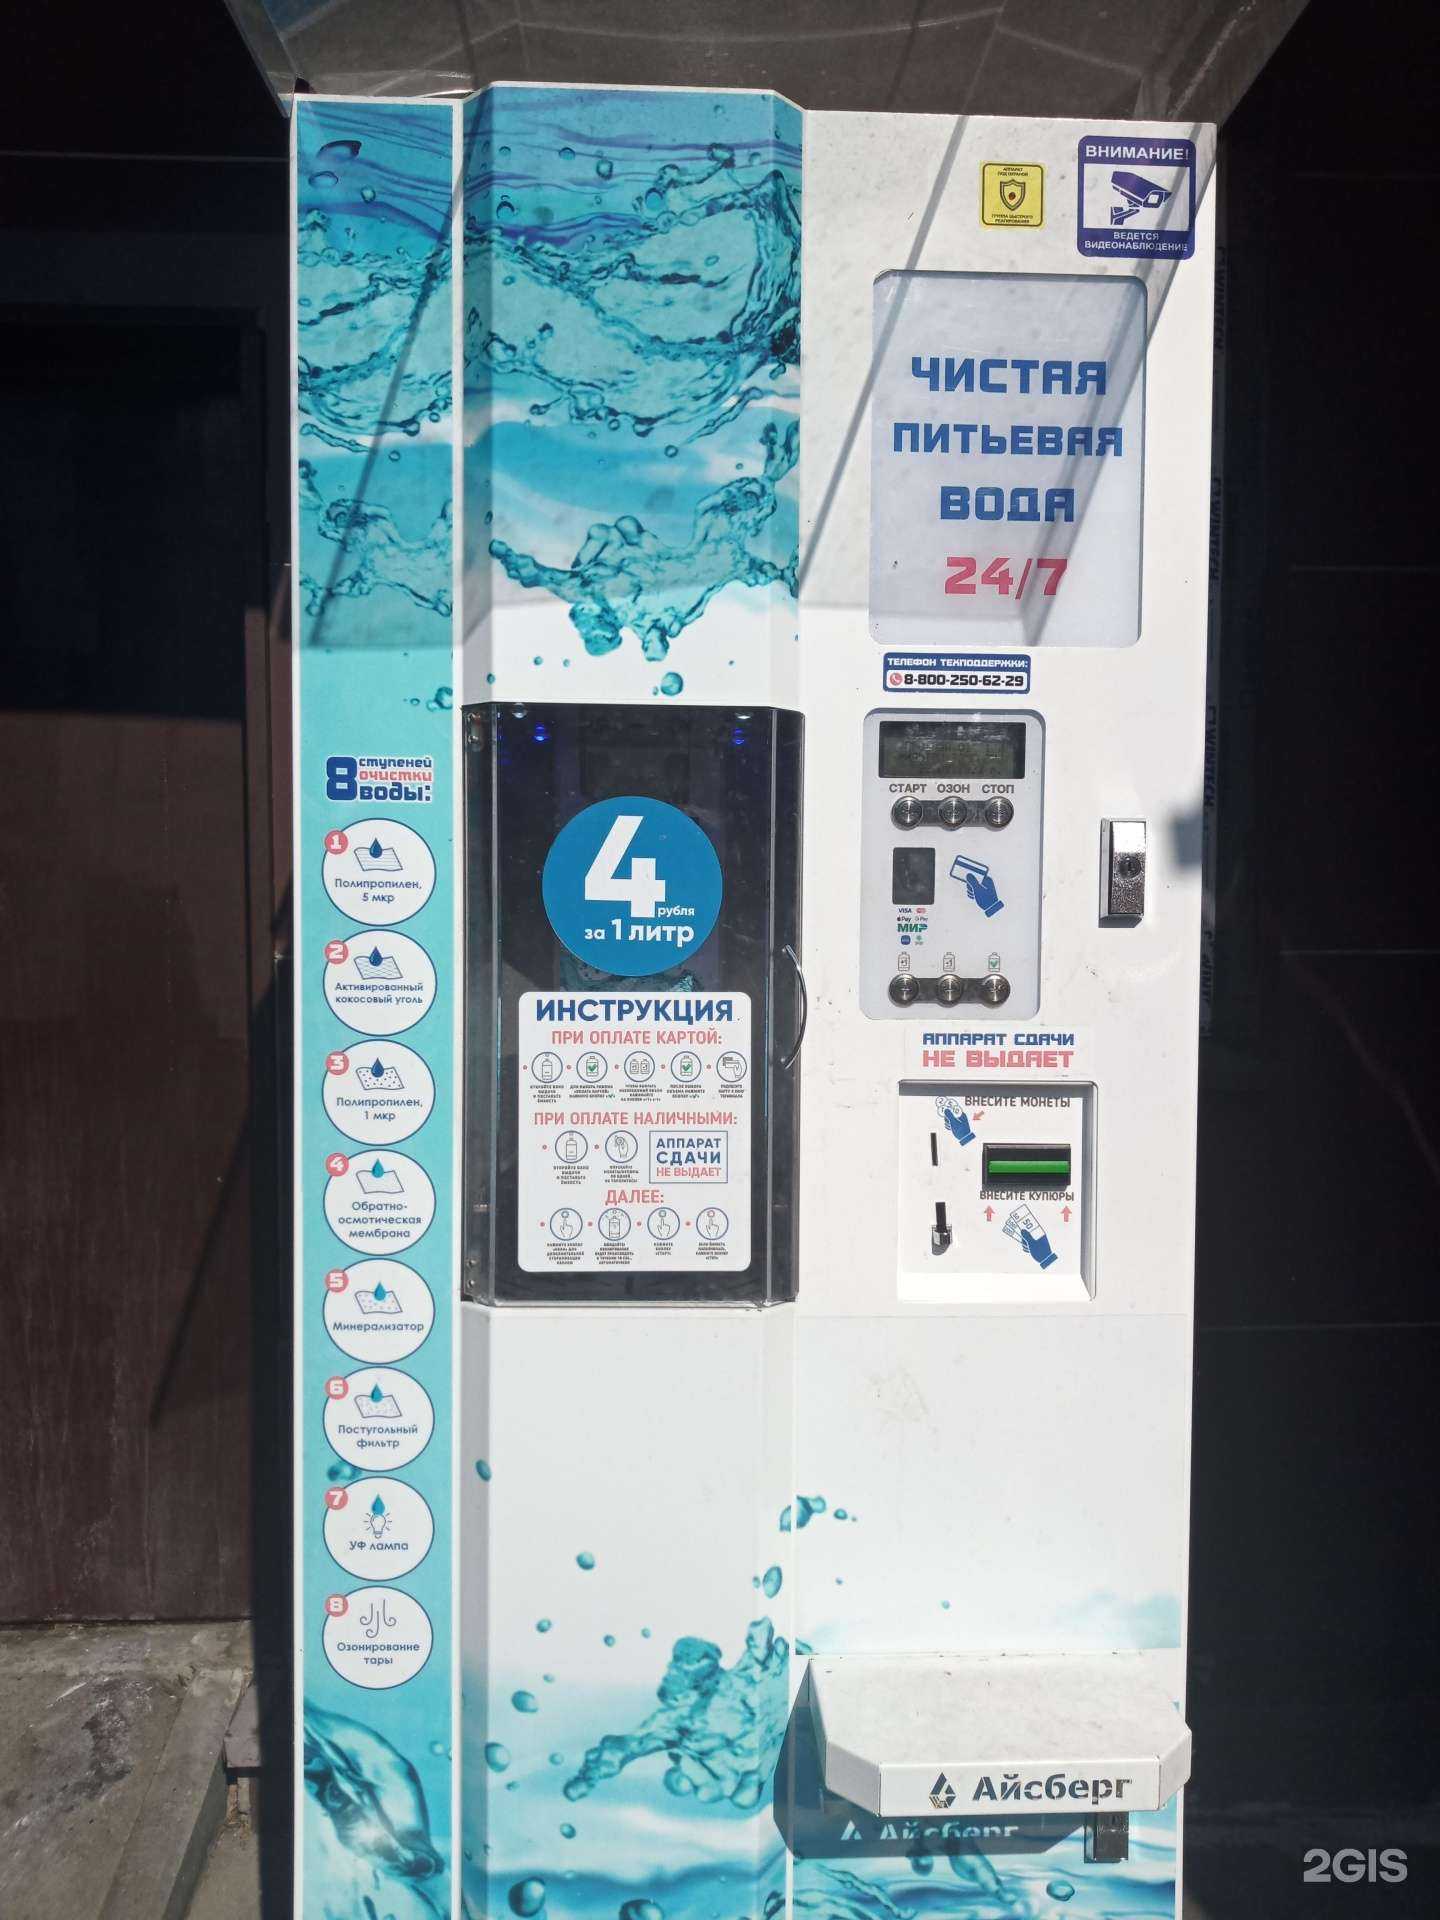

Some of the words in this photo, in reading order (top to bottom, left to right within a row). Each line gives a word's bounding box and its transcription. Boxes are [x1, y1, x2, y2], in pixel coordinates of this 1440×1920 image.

[1086, 145, 1188, 160] ВНИМАНИЕ!
[1113, 232, 1159, 241] ВЕДЕТСЯ
[1084, 241, 1188, 251] ВИДЕОНАБЛЮДЕНИЕ
[911, 356, 1107, 395] ЧИСТАЯ
[893, 423, 1123, 457] ПИТЬЕВАЯ
[940, 486, 1075, 522] ВОДА
[944, 556, 1068, 600] 24/7
[888, 658, 937, 667] ТЕЛЕФОН
[940, 658, 1028, 668] ТЕХПОДДЕРЖКИ:
[904, 674, 1024, 687] 8-800-250-62-29
[359, 757, 432, 769] ступеней
[326, 756, 358, 801] 8
[359, 770, 432, 781] очистки
[359, 785, 432, 801] воды:
[889, 784, 927, 793] СТАРТ
[937, 784, 970, 793] ОЗОН
[982, 784, 1015, 794] СТОП
[331, 835, 342, 850] 1
[585, 815, 666, 918] 4
[335, 878, 422, 893] Полипропилен,
[362, 893, 369, 902] 5
[372, 894, 395, 905] мкр
[657, 906, 695, 918] рубля
[584, 928, 606, 940] за
[611, 919, 622, 941] 1
[628, 925, 695, 948] литр
[329, 944, 344, 960] 2
[335, 982, 424, 994] Активированный
[335, 994, 393, 1004] кокосовый
[395, 995, 423, 1006] уголь
[536, 999, 733, 1025] ИНСТРУКЦИЯ
[552, 1030, 584, 1044] ПРИ
[589, 1030, 650, 1045] ОПЛАТЕ
[656, 1027, 722, 1045] КАРТОЙ:
[923, 1033, 1007, 1045] АППАРАТ
[1014, 1033, 1075, 1046] СДАЧИ
[330, 1055, 345, 1071] 3
[923, 1050, 956, 1067] НЕ
[966, 1050, 1074, 1068] ВЫДАЕТ
[336, 1097, 423, 1110] Полипропилен,
[964, 1096, 1017, 1107] ВНЕСИТЕ
[1020, 1097, 1071, 1108] МОНЕТЫ
[364, 1110, 370, 1121] 1
[373, 1112, 396, 1123] мкр
[534, 1112, 565, 1125] ПРИ
[570, 1112, 629, 1125] ОПЛАТЕ
[634, 1111, 738, 1125] НАЛИЧНЫМИ:
[656, 1138, 722, 1149] АППАРАТ
[330, 1157, 344, 1172] 4
[656, 1151, 721, 1166] СДАЧИ
[656, 1167, 671, 1177] НЕ
[673, 1167, 722, 1178] ВЫДАЕТ
[605, 1190, 664, 1206] ДАЛЕЕ:
[980, 1190, 1026, 1201] ВНЕСИТЕ
[1029, 1191, 1075, 1201] КУПЮРЫ
[352, 1201, 408, 1214] Обратно-
[338, 1216, 422, 1225] осмотическая
[1022, 1218, 1033, 1230] 50
[348, 1228, 410, 1239] мембрана
[329, 1273, 343, 1288] 5
[332, 1321, 425, 1334] Минерализатор
[329, 1380, 344, 1395] 6
[338, 1424, 418, 1437] Постугольный
[356, 1437, 400, 1450] фильтр
[330, 1490, 343, 1506] 7
[349, 1540, 367, 1551] УФ
[369, 1541, 409, 1551] лампа
[330, 1598, 344, 1613] 8
[336, 1642, 420, 1654] Озонирование
[363, 1656, 393, 1667] тары
[972, 1773, 1132, 1806] Айсберг
